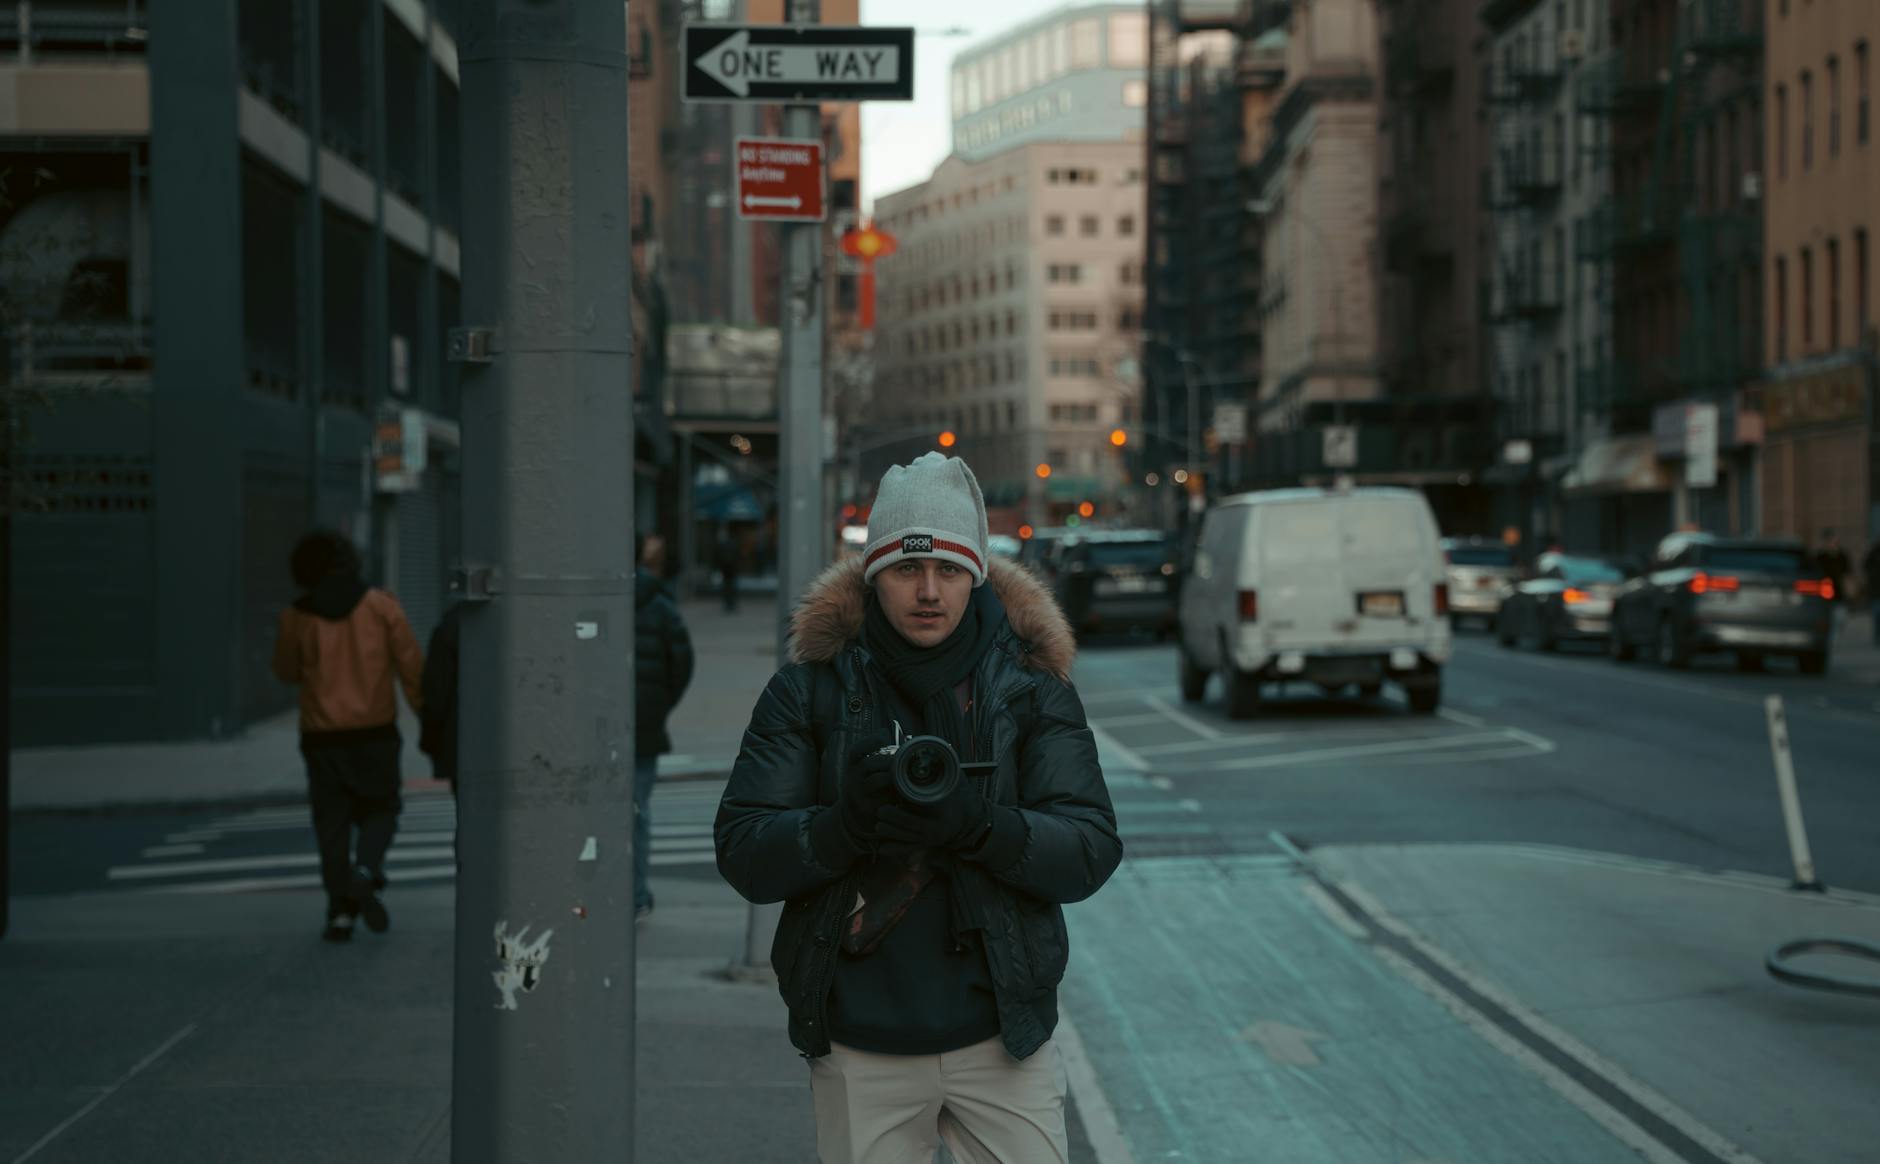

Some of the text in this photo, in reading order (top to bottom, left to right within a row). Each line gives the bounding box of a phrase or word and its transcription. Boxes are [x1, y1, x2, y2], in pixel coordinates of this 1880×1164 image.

[719, 49, 884, 78] ONE WAY
[760, 148, 811, 166] STANDING
[742, 167, 786, 184] Anytime
